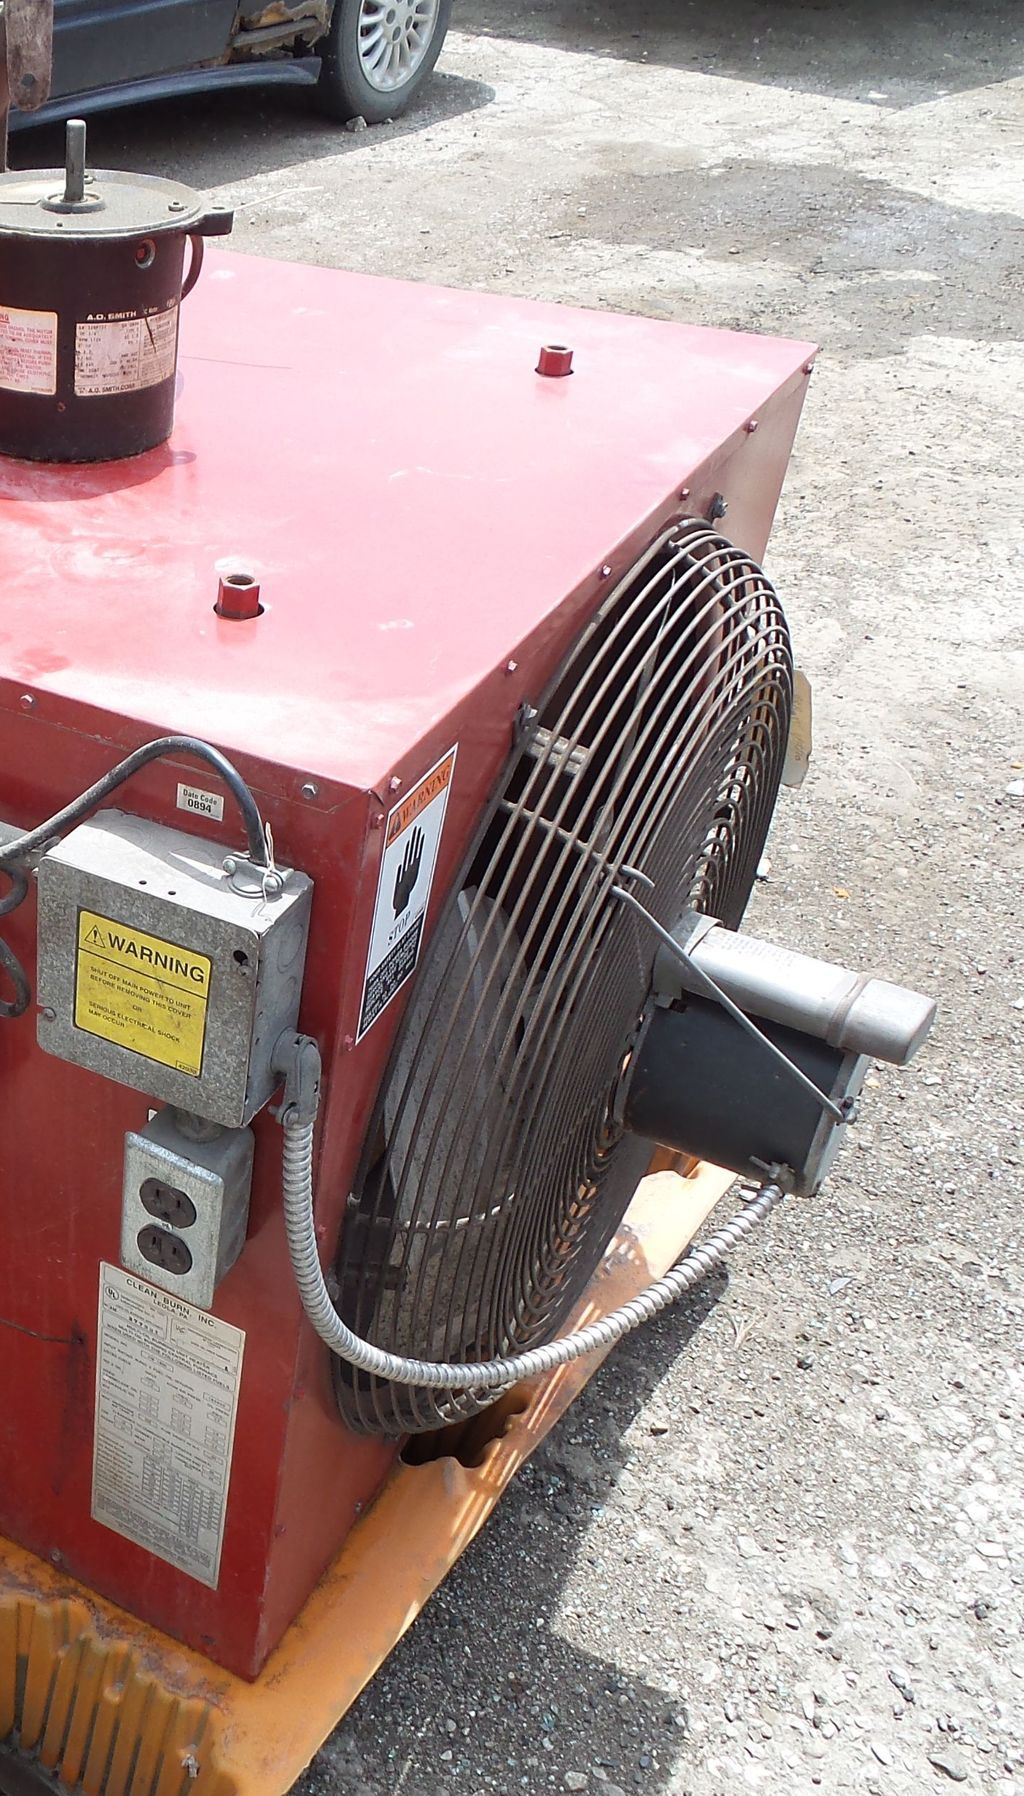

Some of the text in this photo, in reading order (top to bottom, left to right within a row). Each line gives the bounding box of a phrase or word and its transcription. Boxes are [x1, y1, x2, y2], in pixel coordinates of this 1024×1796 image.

[86, 311, 137, 321] A.O. SMITH
[183, 788, 218, 806] Date Code
[187, 798, 212, 813] 0894
[107, 932, 204, 983] WARNING
[90, 966, 190, 1010] SHUT OFF MAIN POWER TO UNIT
[90, 974, 191, 1019] BEFORE REMOVING THIS COVER
[88, 1008, 124, 1027] MAY OCCUR
[89, 1000, 179, 1043] SERIOUS ELECTRICAL SHOCK
[132, 1004, 141, 1012] OR
[126, 1278, 157, 1299] CLEAN
[198, 1314, 217, 1329] INC.
